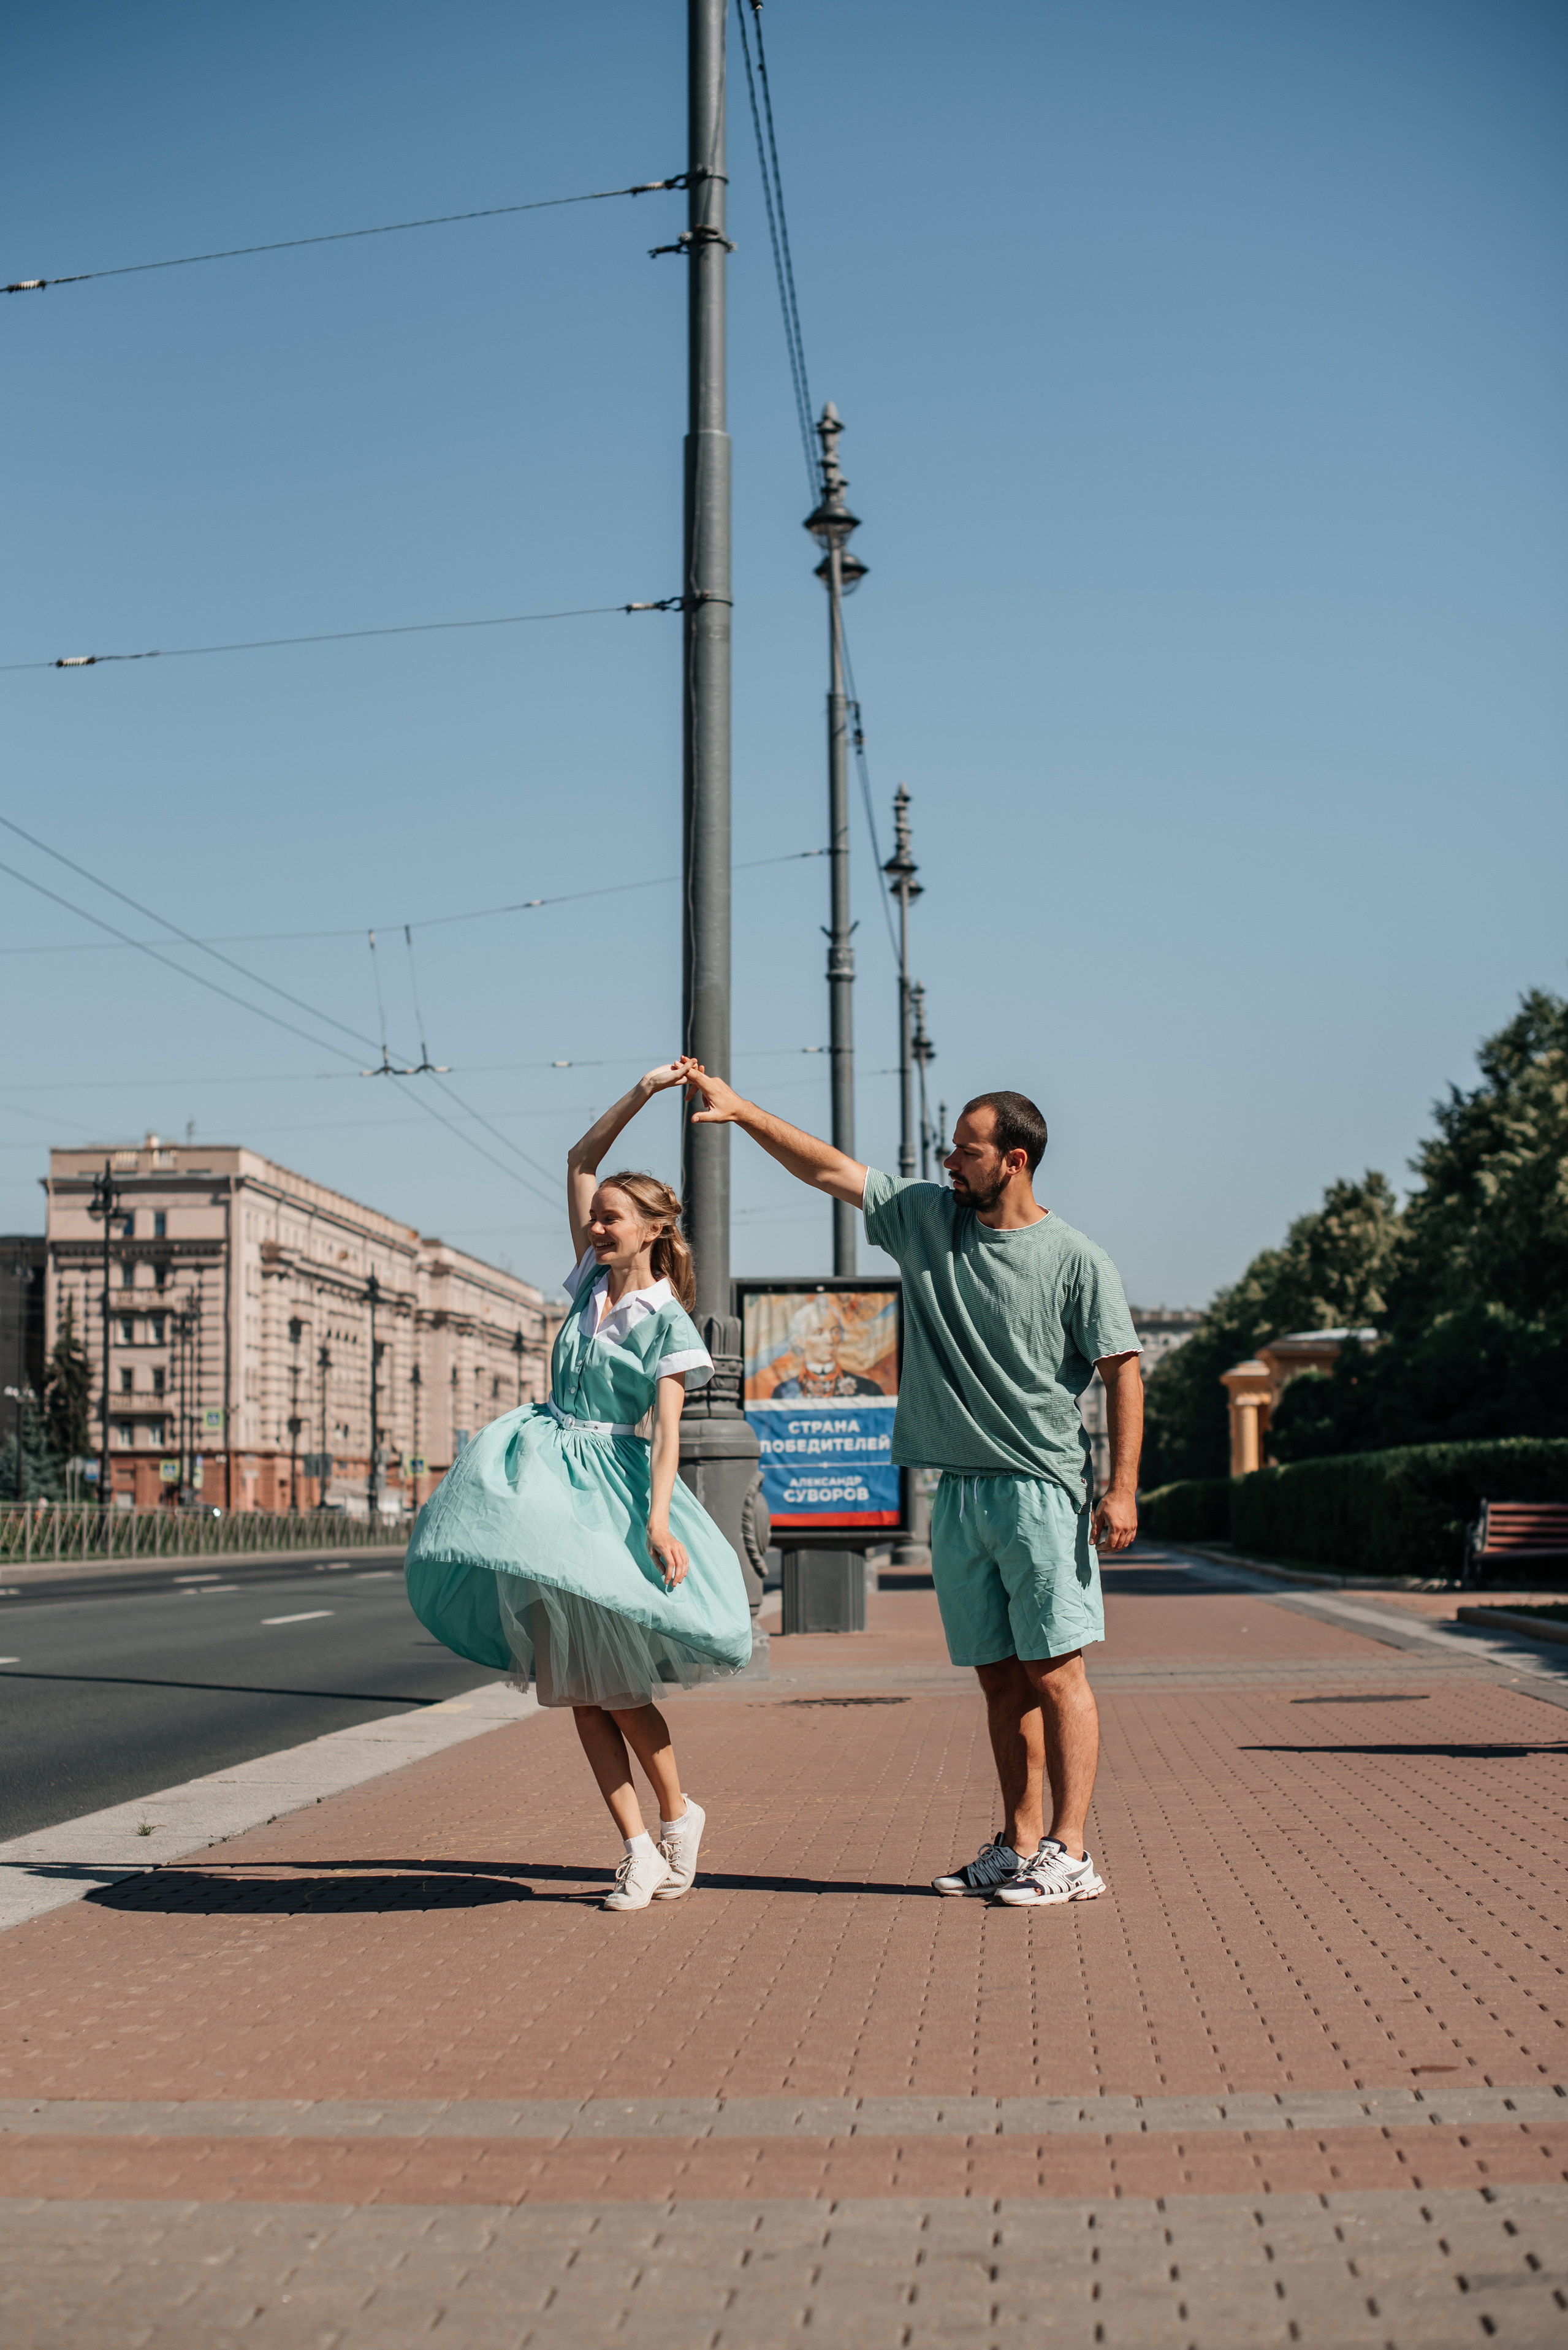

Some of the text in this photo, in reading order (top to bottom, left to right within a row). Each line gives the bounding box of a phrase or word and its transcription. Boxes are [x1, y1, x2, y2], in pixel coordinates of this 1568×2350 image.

[788, 1420, 860, 1434] СТРАНА
[760, 1434, 891, 1454] ПОБЕДИТЕЛЕЙ
[790, 1475, 862, 1487] АЛЕКСАНДР
[783, 1487, 869, 1502] СУВОРОВ
